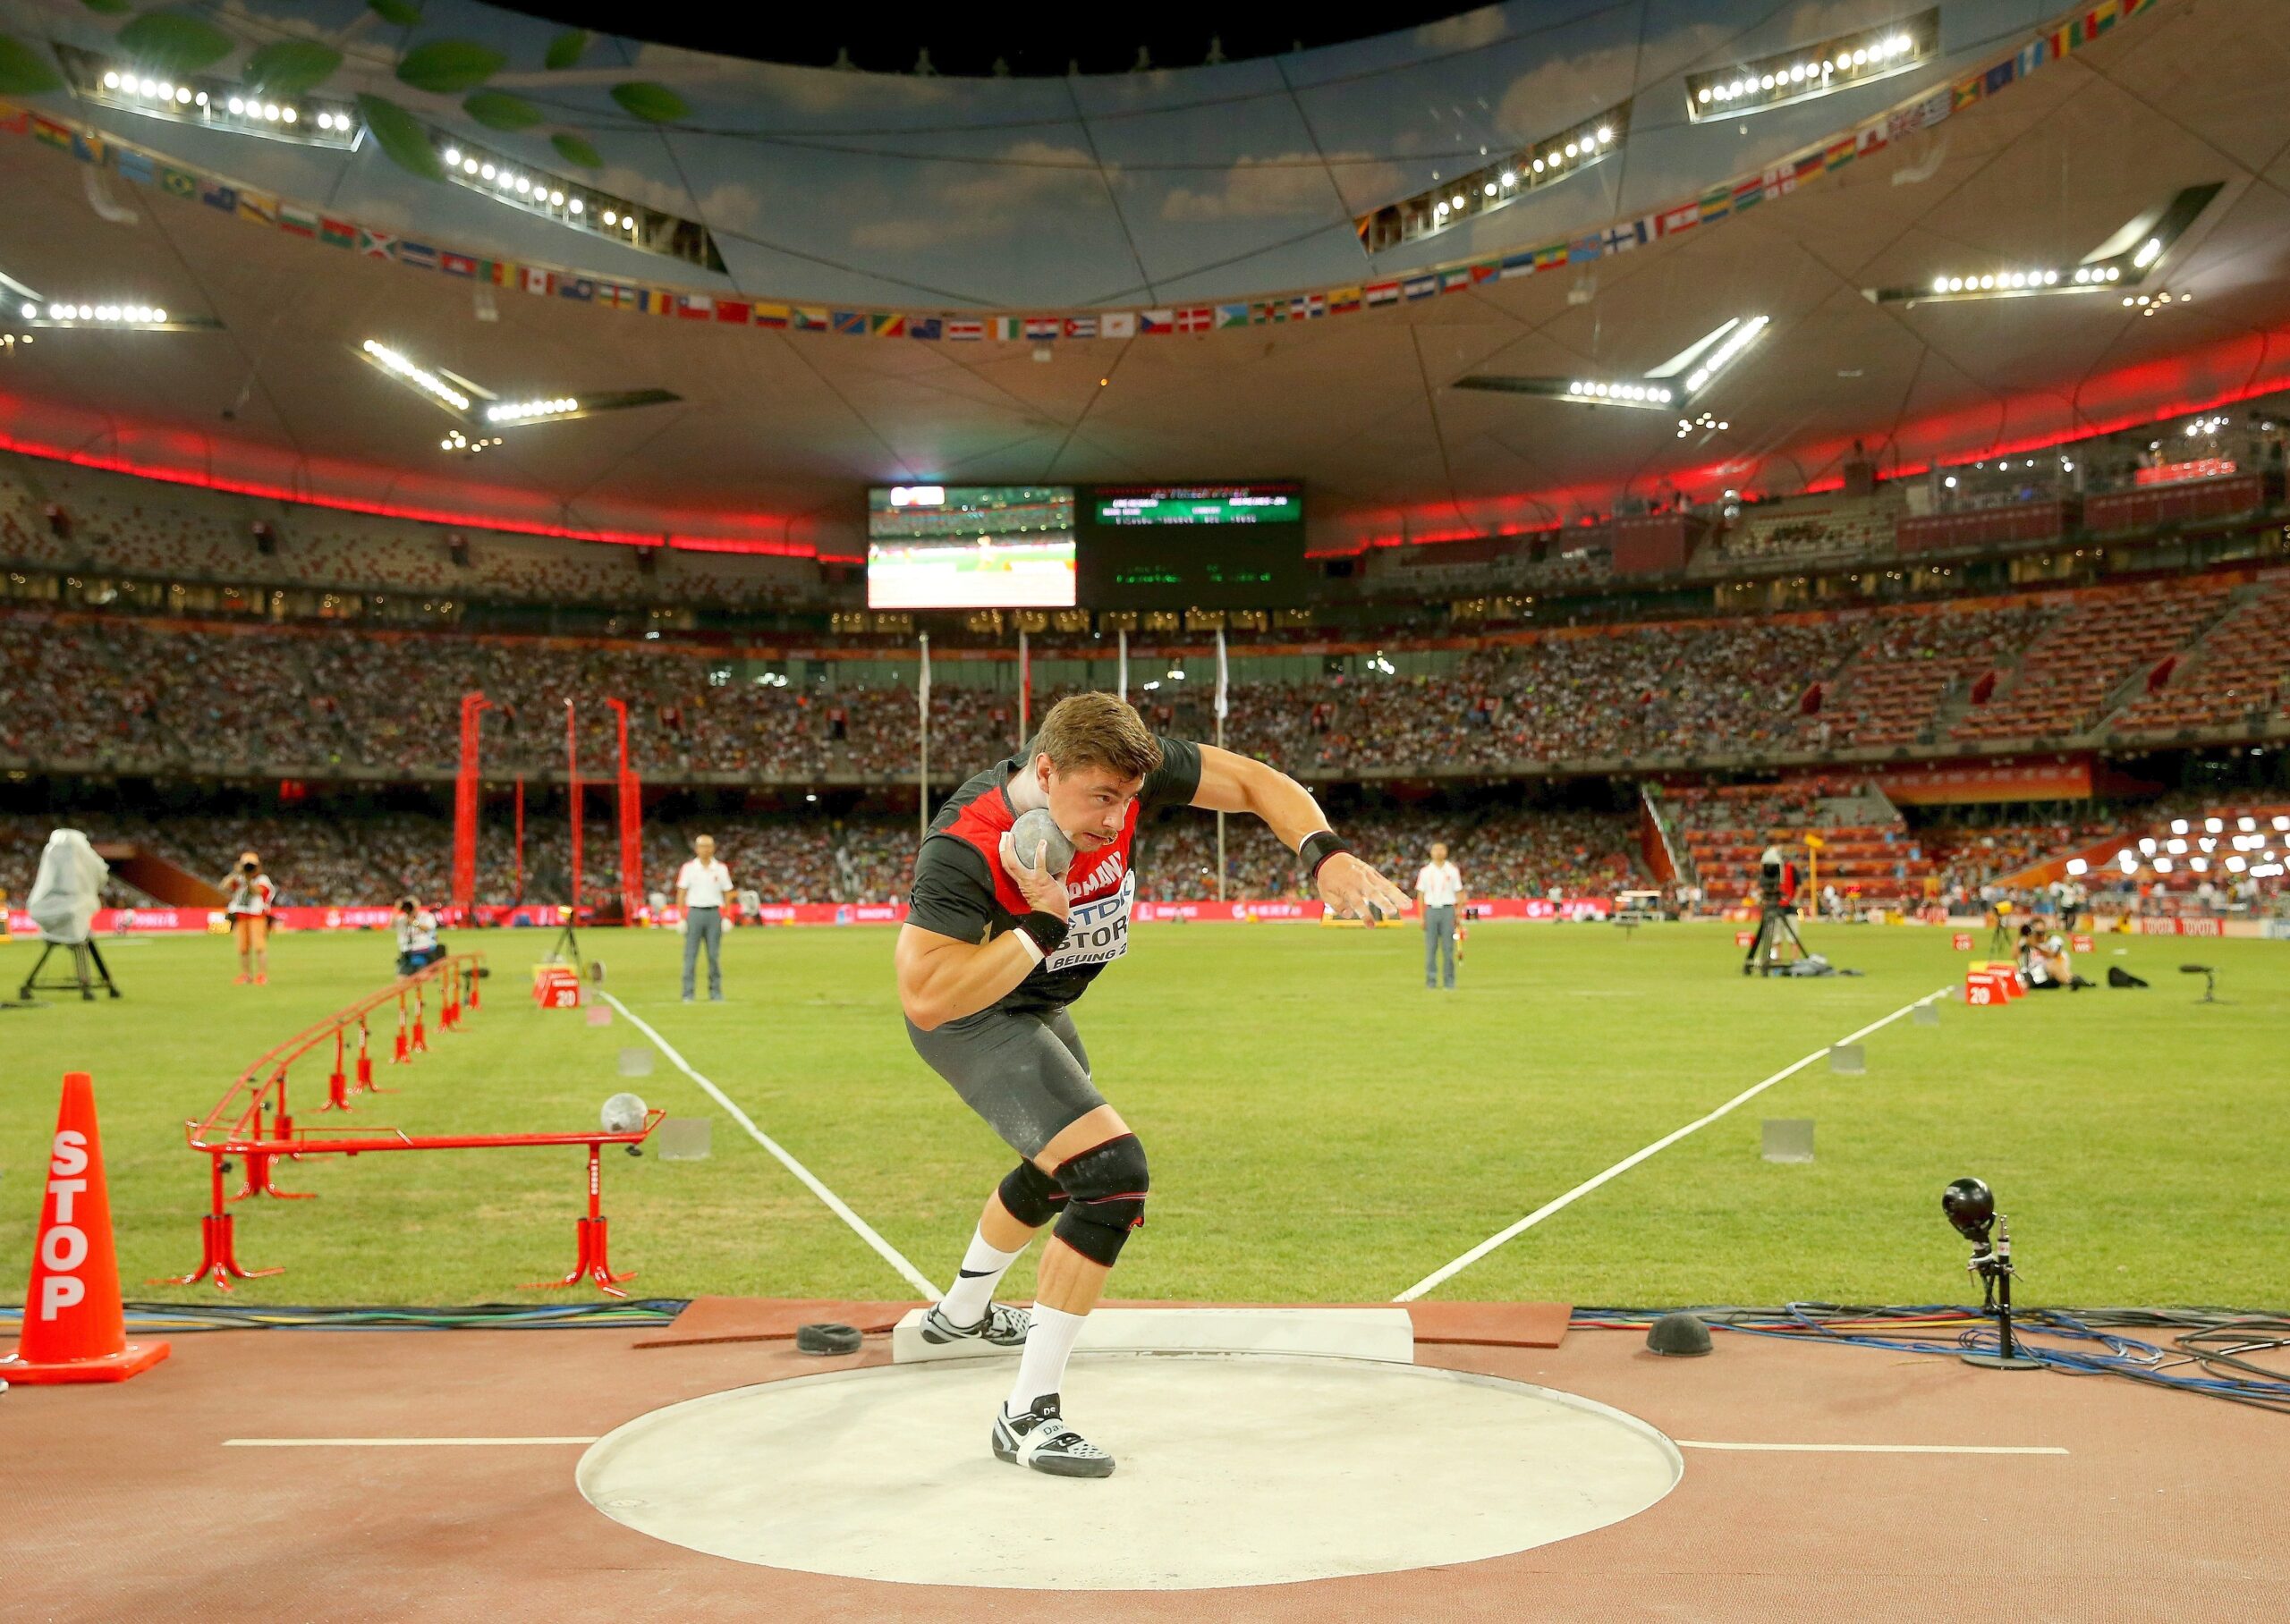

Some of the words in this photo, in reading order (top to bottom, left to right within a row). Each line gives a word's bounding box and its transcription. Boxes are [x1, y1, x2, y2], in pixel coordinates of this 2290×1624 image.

[1054, 949, 1115, 969] BEIJING
[556, 990, 576, 1007] 20
[1970, 986, 1990, 1004] 20
[41, 1130, 89, 1321] STOP
